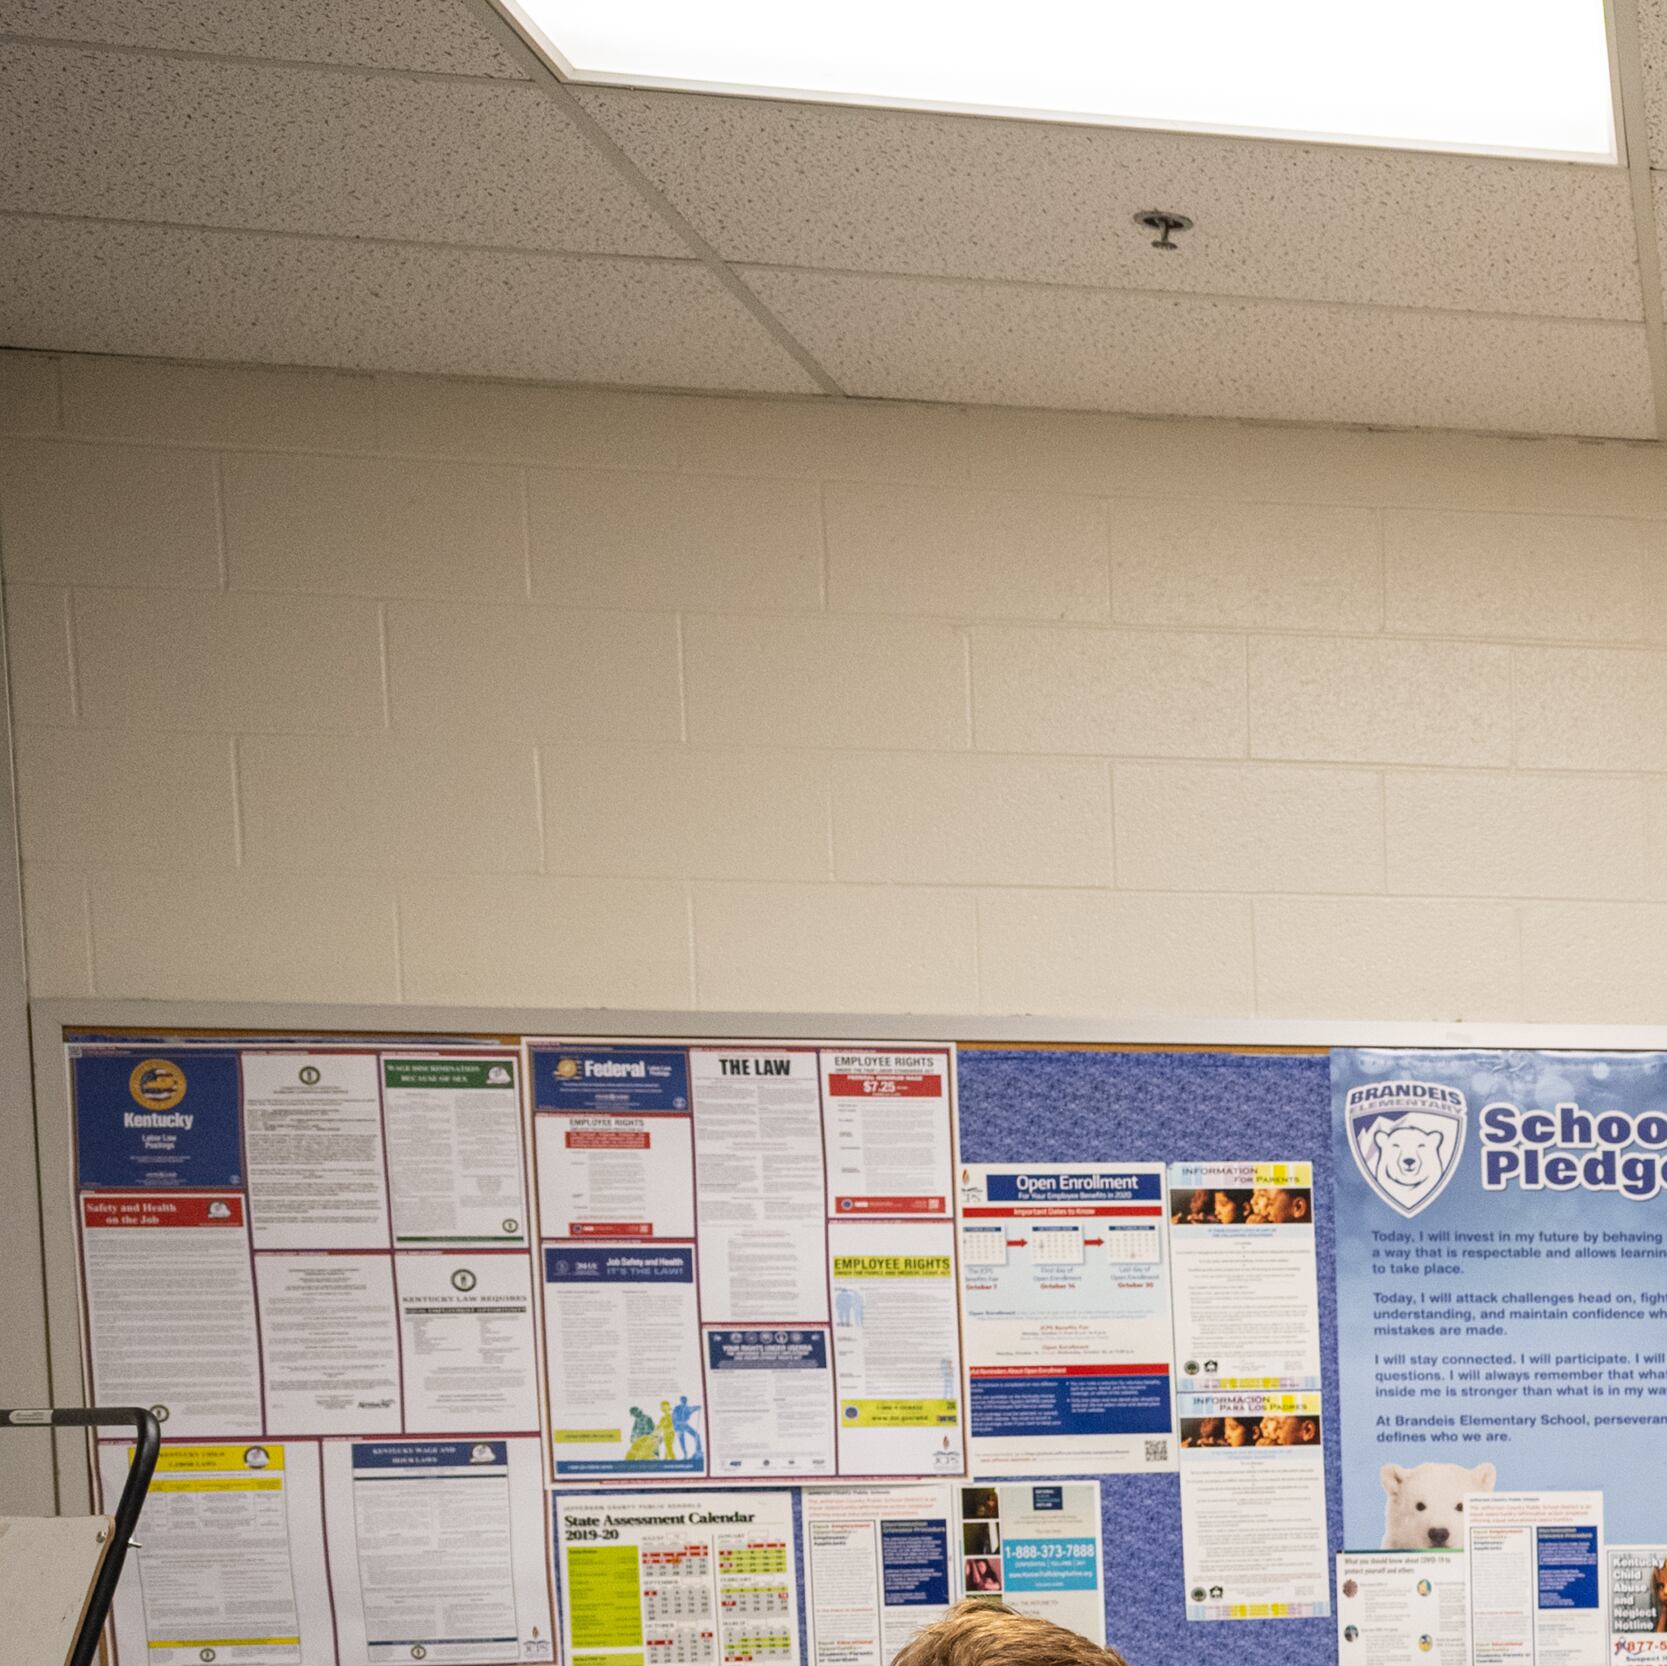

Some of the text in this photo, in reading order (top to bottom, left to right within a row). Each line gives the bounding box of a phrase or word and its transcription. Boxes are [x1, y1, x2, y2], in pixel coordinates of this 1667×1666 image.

[719, 1059, 790, 1075] THE LAW
[835, 1056, 935, 1067] EMPLOYEE RIGHTS
[585, 1060, 646, 1078] Federal
[862, 1080, 896, 1094] $7.25
[1349, 1083, 1463, 1107] BRANDEIS
[1350, 1099, 1463, 1115] ELEMENTARY
[124, 1112, 194, 1130] Kentucky
[1182, 1167, 1258, 1176] INFORMATION
[1016, 1174, 1139, 1193] Open Enrollment
[1234, 1175, 1300, 1184] FOR PARENTS
[86, 1202, 177, 1214] Safety and Health
[106, 1215, 160, 1225] on the Job
[1371, 1231, 1414, 1243] Today,
[1419, 1230, 1424, 1242] I
[1428, 1231, 1449, 1242] will
[1455, 1231, 1494, 1242] invest
[1499, 1231, 1511, 1241] in
[1515, 1234, 1534, 1244] my
[1539, 1231, 1579, 1242] future
[1584, 1231, 1598, 1244] by
[1603, 1231, 1662, 1244] behaving
[1372, 1249, 1380, 1257] a
[1385, 1250, 1411, 1260] way
[1416, 1247, 1442, 1258] that
[1447, 1248, 1457, 1257] is
[1462, 1247, 1541, 1260] respectable
[1546, 1247, 1570, 1258] and
[1575, 1247, 1616, 1258] allows
[606, 1257, 684, 1268] Job Safety and Health
[835, 1257, 950, 1270] EMPLOYEE RIGHTS
[1372, 1263, 1464, 1276] to take place.
[1373, 1292, 1416, 1306] Today,
[1420, 1291, 1425, 1304] I
[1429, 1293, 1451, 1303] will
[1456, 1293, 1498, 1303] attack
[1502, 1293, 1574, 1306] challenges
[1579, 1293, 1611, 1303] head
[1616, 1295, 1636, 1304] on,
[1374, 1309, 1475, 1322] understanding,
[1480, 1308, 1505, 1319] and
[1510, 1309, 1568, 1319] maintain
[1572, 1308, 1644, 1319] confidence
[1374, 1325, 1507, 1335] mistakes are made.
[1376, 1416, 1390, 1426] At
[1395, 1416, 1455, 1426] Brandeis
[1460, 1415, 1536, 1427] Elementary
[1541, 1415, 1590, 1425] School,
[1377, 1432, 1426, 1442] defines
[1431, 1432, 1458, 1441] who
[1486, 1433, 1511, 1441] are.
[565, 1512, 755, 1527] State Assessment Calendar
[566, 1529, 619, 1541] 2019-20
[1005, 1543, 1094, 1559] 1-888-373-7888
[1613, 1558, 1664, 1569] Kentucky
[1614, 1570, 1642, 1581] Child
[1613, 1582, 1648, 1593] Abuse
[1614, 1596, 1635, 1606] and
[1614, 1608, 1657, 1619] Neglect
[1614, 1620, 1654, 1631] Hotline
